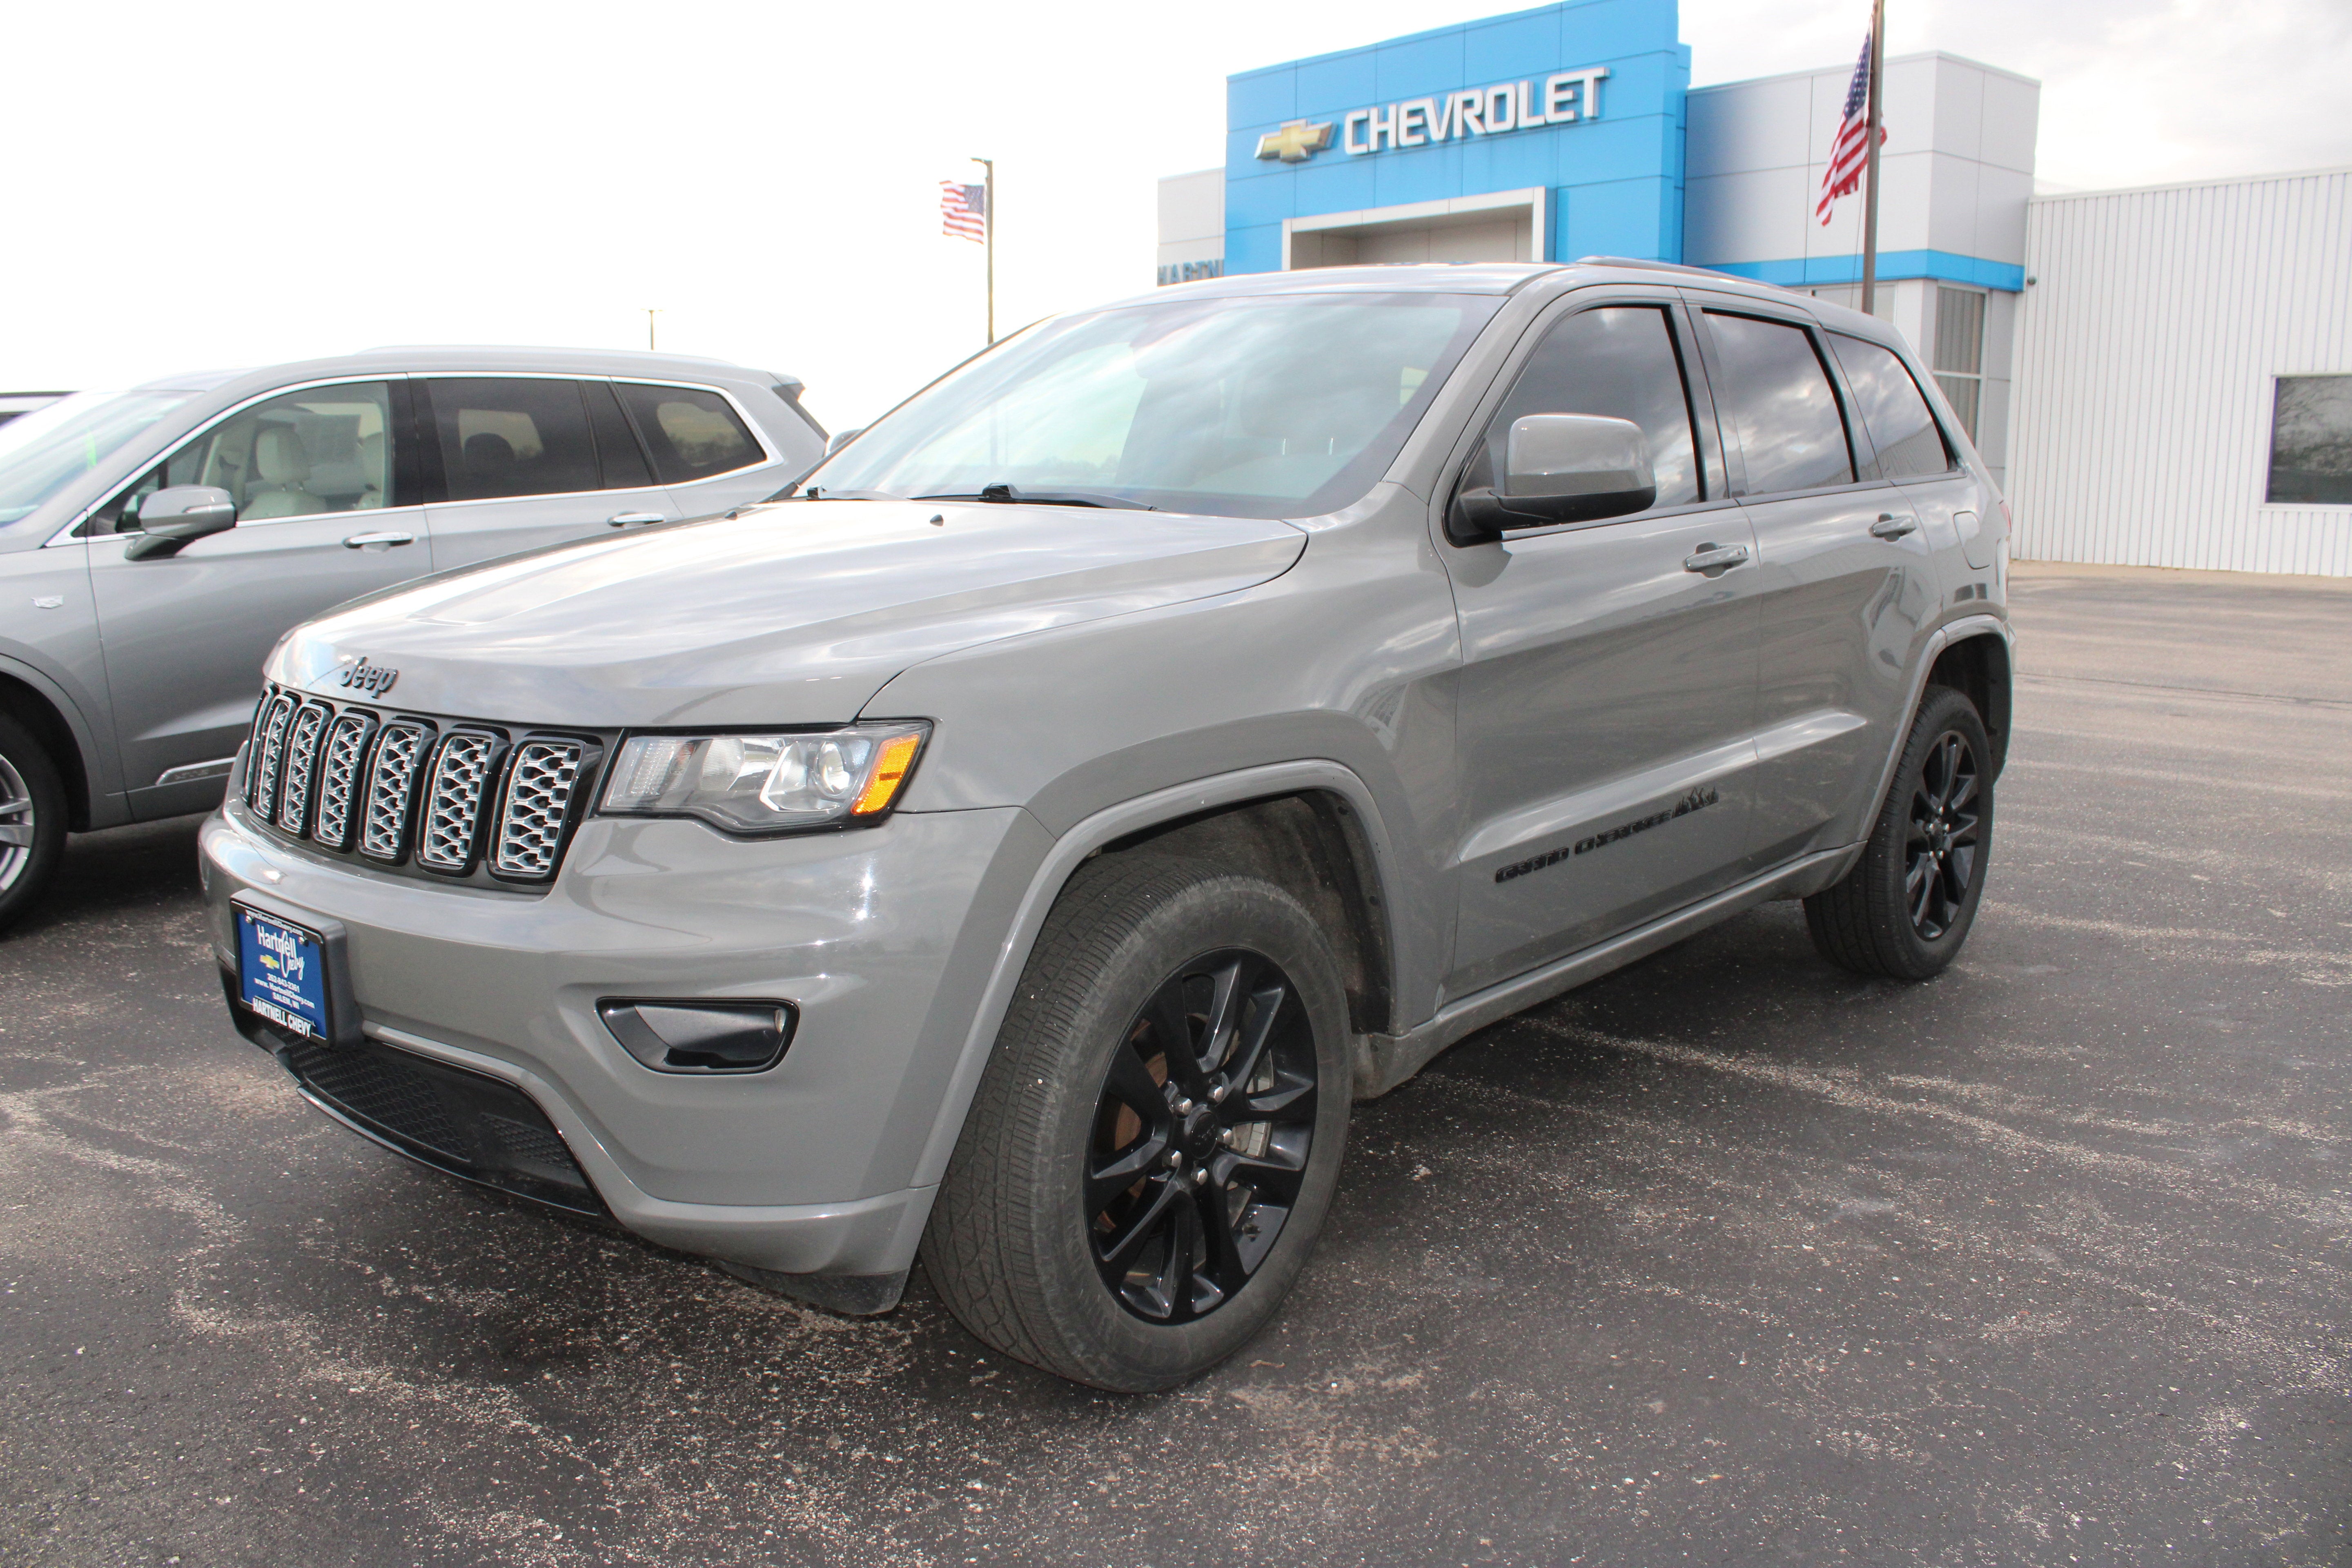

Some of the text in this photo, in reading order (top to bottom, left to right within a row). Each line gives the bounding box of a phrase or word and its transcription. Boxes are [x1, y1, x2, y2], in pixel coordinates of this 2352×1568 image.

[1344, 67, 1610, 155] CHEVROLET
[340, 656, 399, 699] Jeep
[256, 924, 297, 960] Hartnell
[252, 997, 312, 1037] HARTNELL CHEVY
